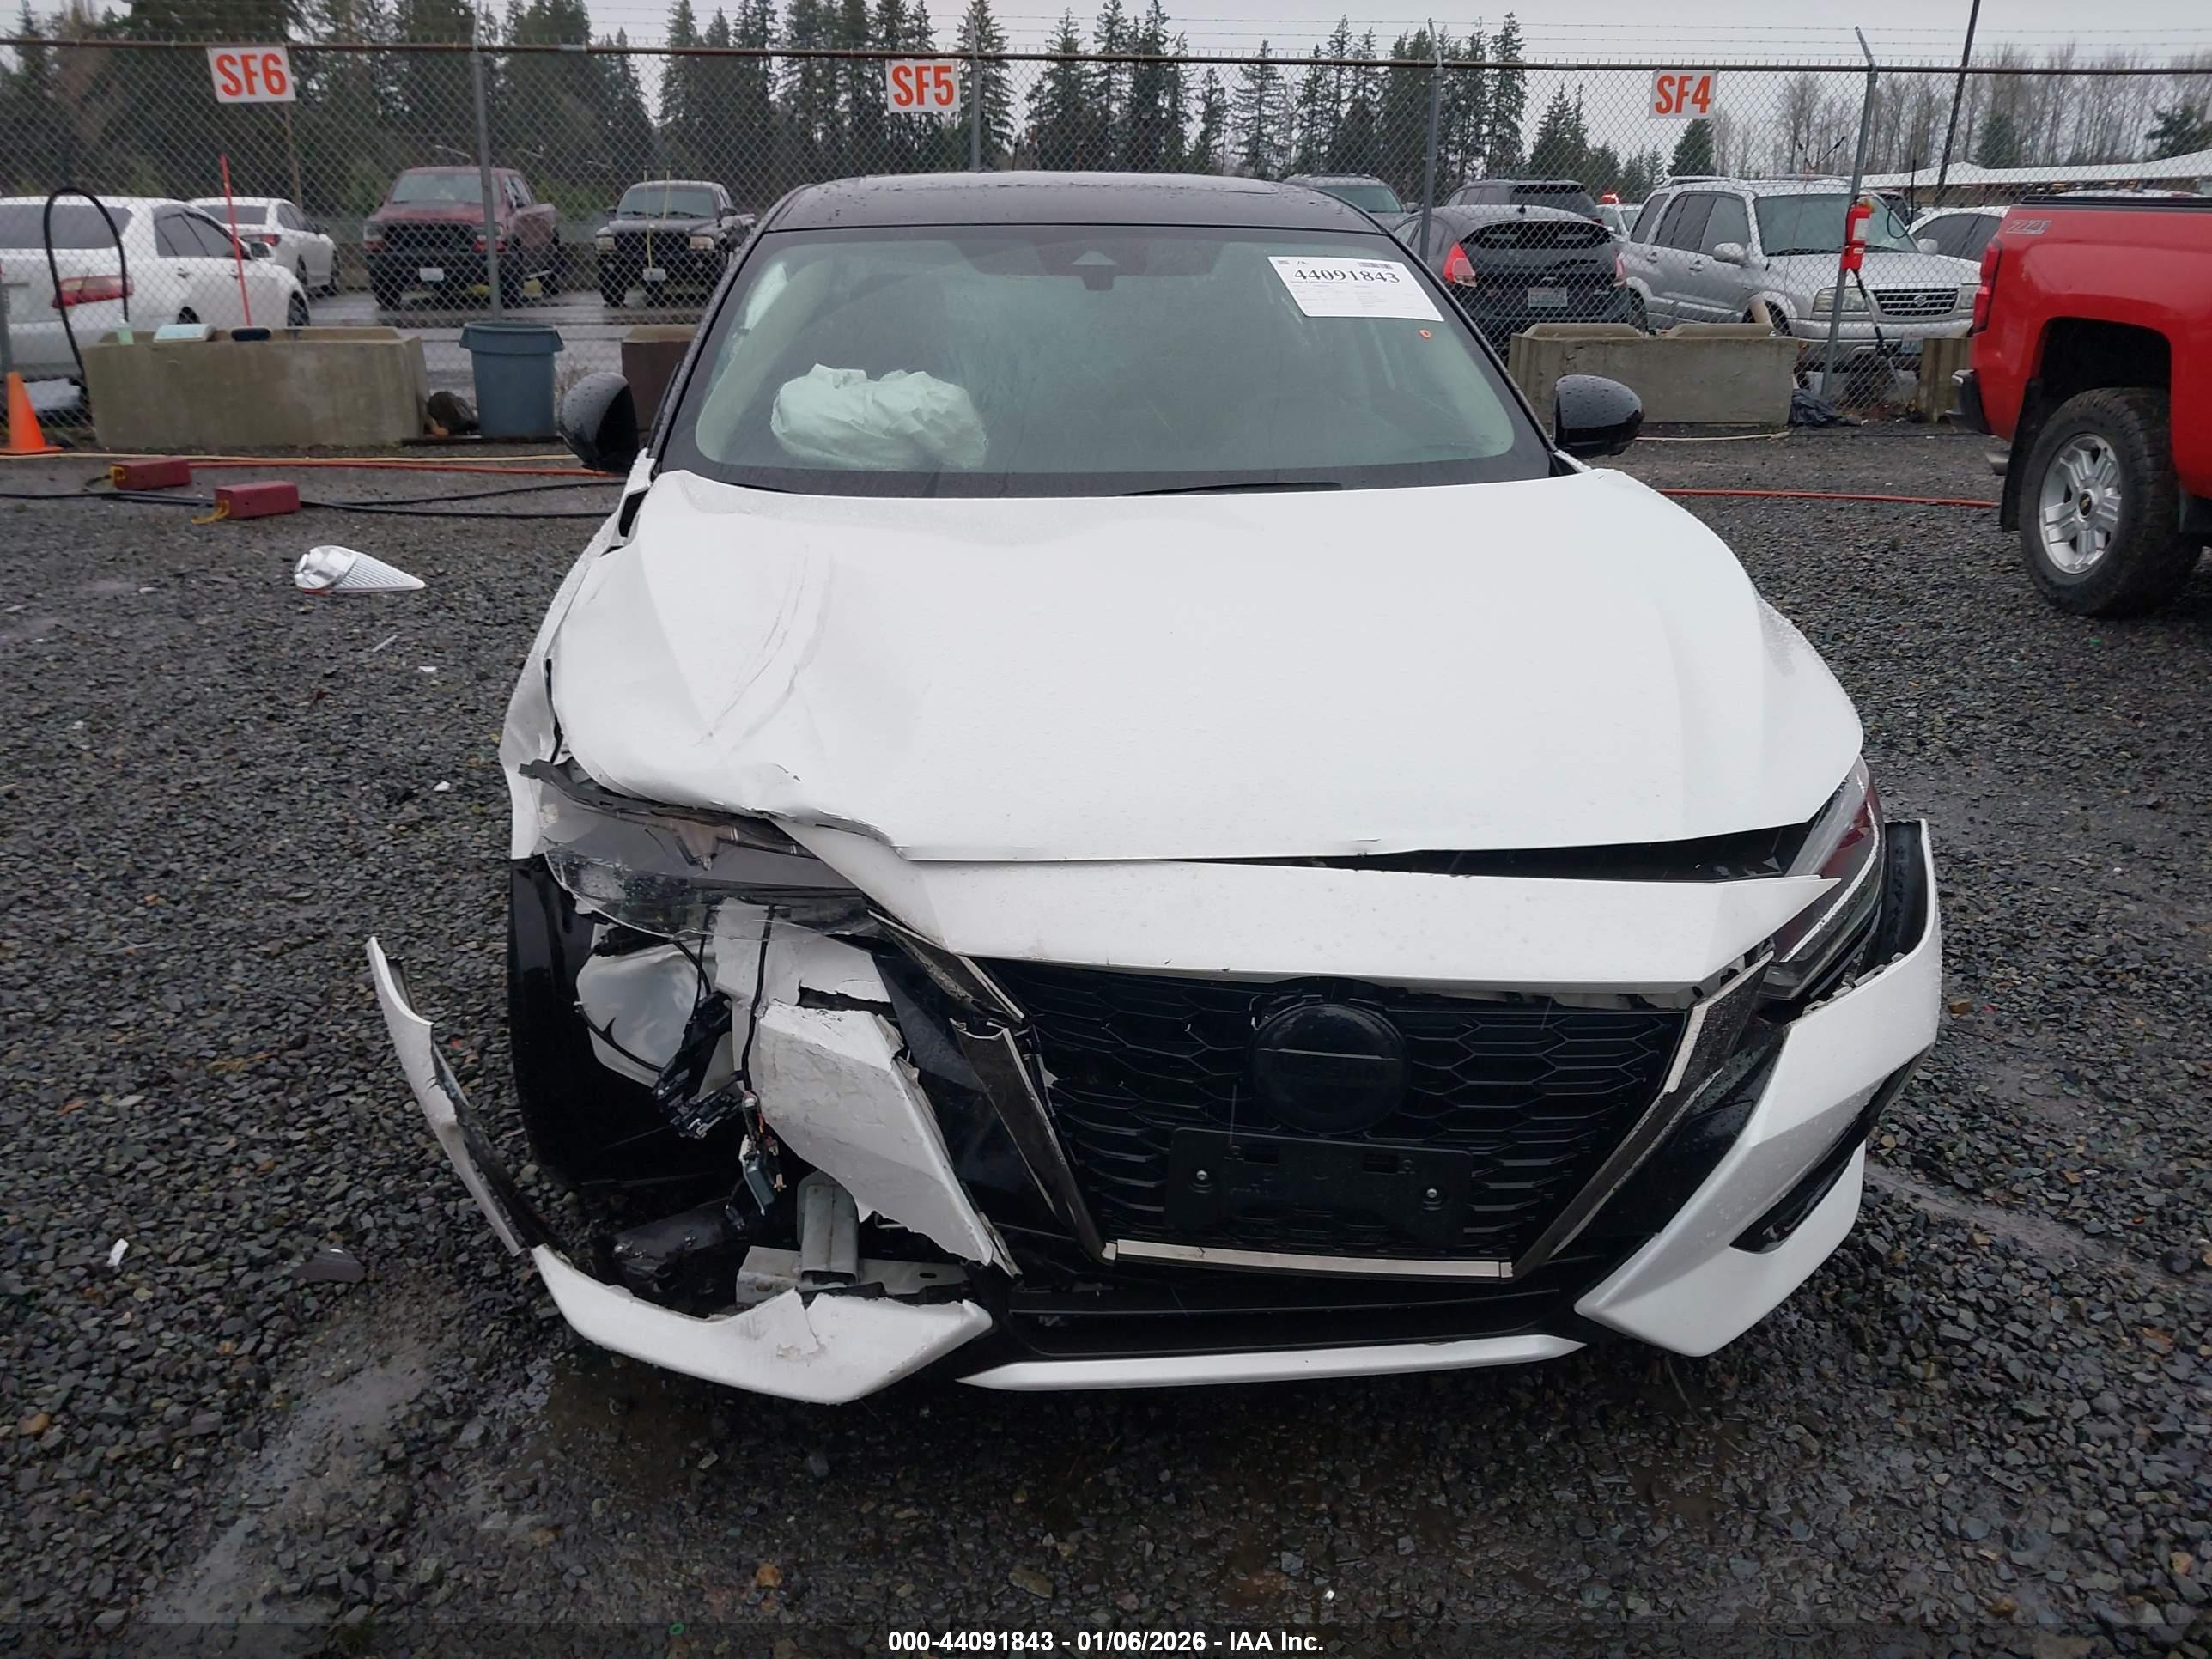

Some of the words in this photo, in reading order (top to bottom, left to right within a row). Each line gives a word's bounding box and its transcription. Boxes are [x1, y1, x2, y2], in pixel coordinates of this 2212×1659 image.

[216, 53, 287, 96] SF6
[892, 65, 954, 106] SF5
[1655, 75, 1711, 114] SF4
[1294, 269, 1401, 283] 44091843
